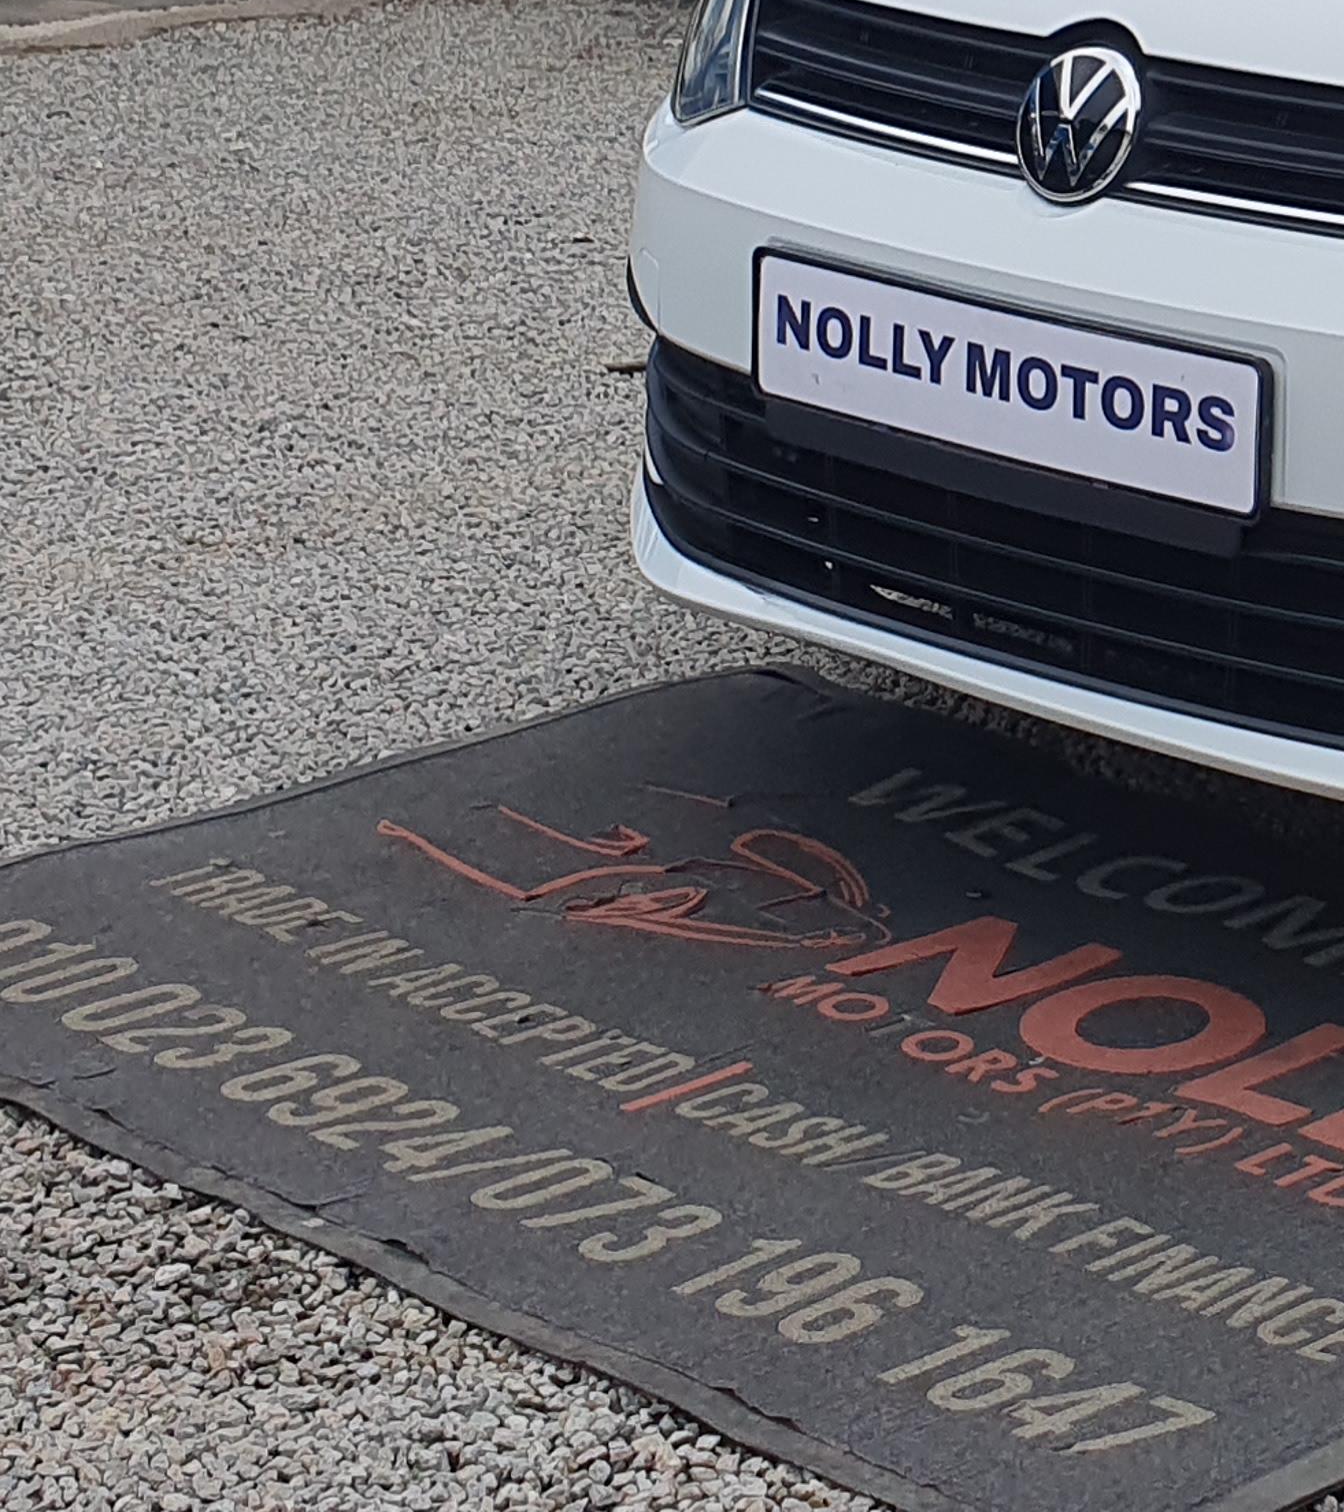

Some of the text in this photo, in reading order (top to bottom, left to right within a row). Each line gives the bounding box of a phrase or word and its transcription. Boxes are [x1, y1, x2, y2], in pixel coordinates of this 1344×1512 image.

[776, 294, 1236, 452] NOLLY MOTORS
[149, 857, 364, 943] TRADE
[306, 931, 424, 975] IN
[62, 983, 293, 1069] 023
[671, 1238, 924, 1344] 196
[877, 1324, 1216, 1454] 1647
